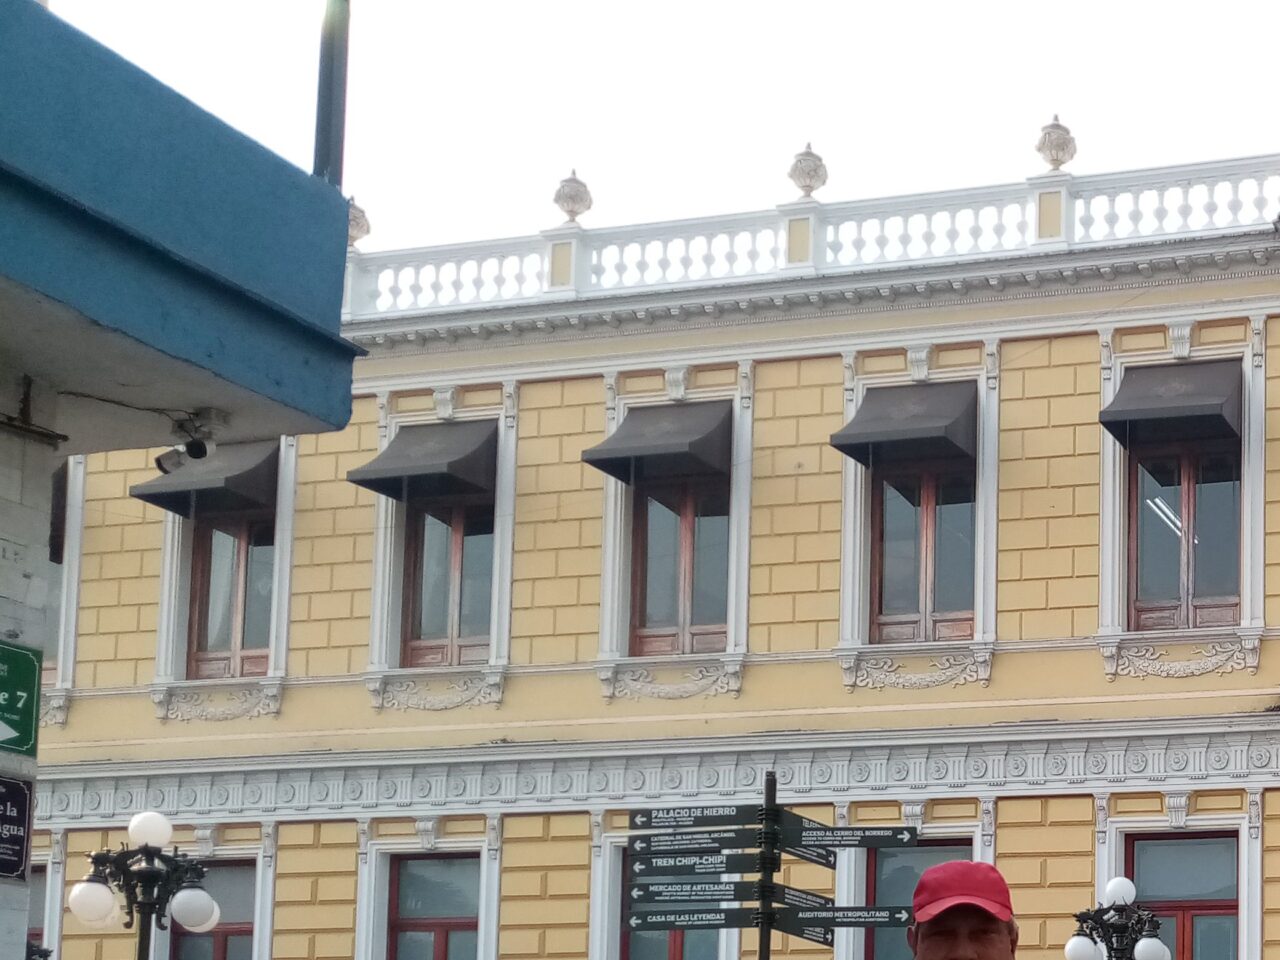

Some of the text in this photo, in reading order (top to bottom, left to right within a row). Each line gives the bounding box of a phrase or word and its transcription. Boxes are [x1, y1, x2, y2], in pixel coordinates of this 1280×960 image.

[16, 691, 28, 708] 7
[6, 801, 18, 817] la
[651, 807, 737, 818] PALACIO DE HIERRO
[0, 823, 24, 839] gua
[651, 855, 727, 867] TREN CHIPI-CHIPI
[649, 884, 681, 892] MERCADO
[692, 883, 735, 891] ARTESANÍAS
[690, 913, 725, 921] LEYENDAS
[834, 910, 890, 918] METROPOLITANO
